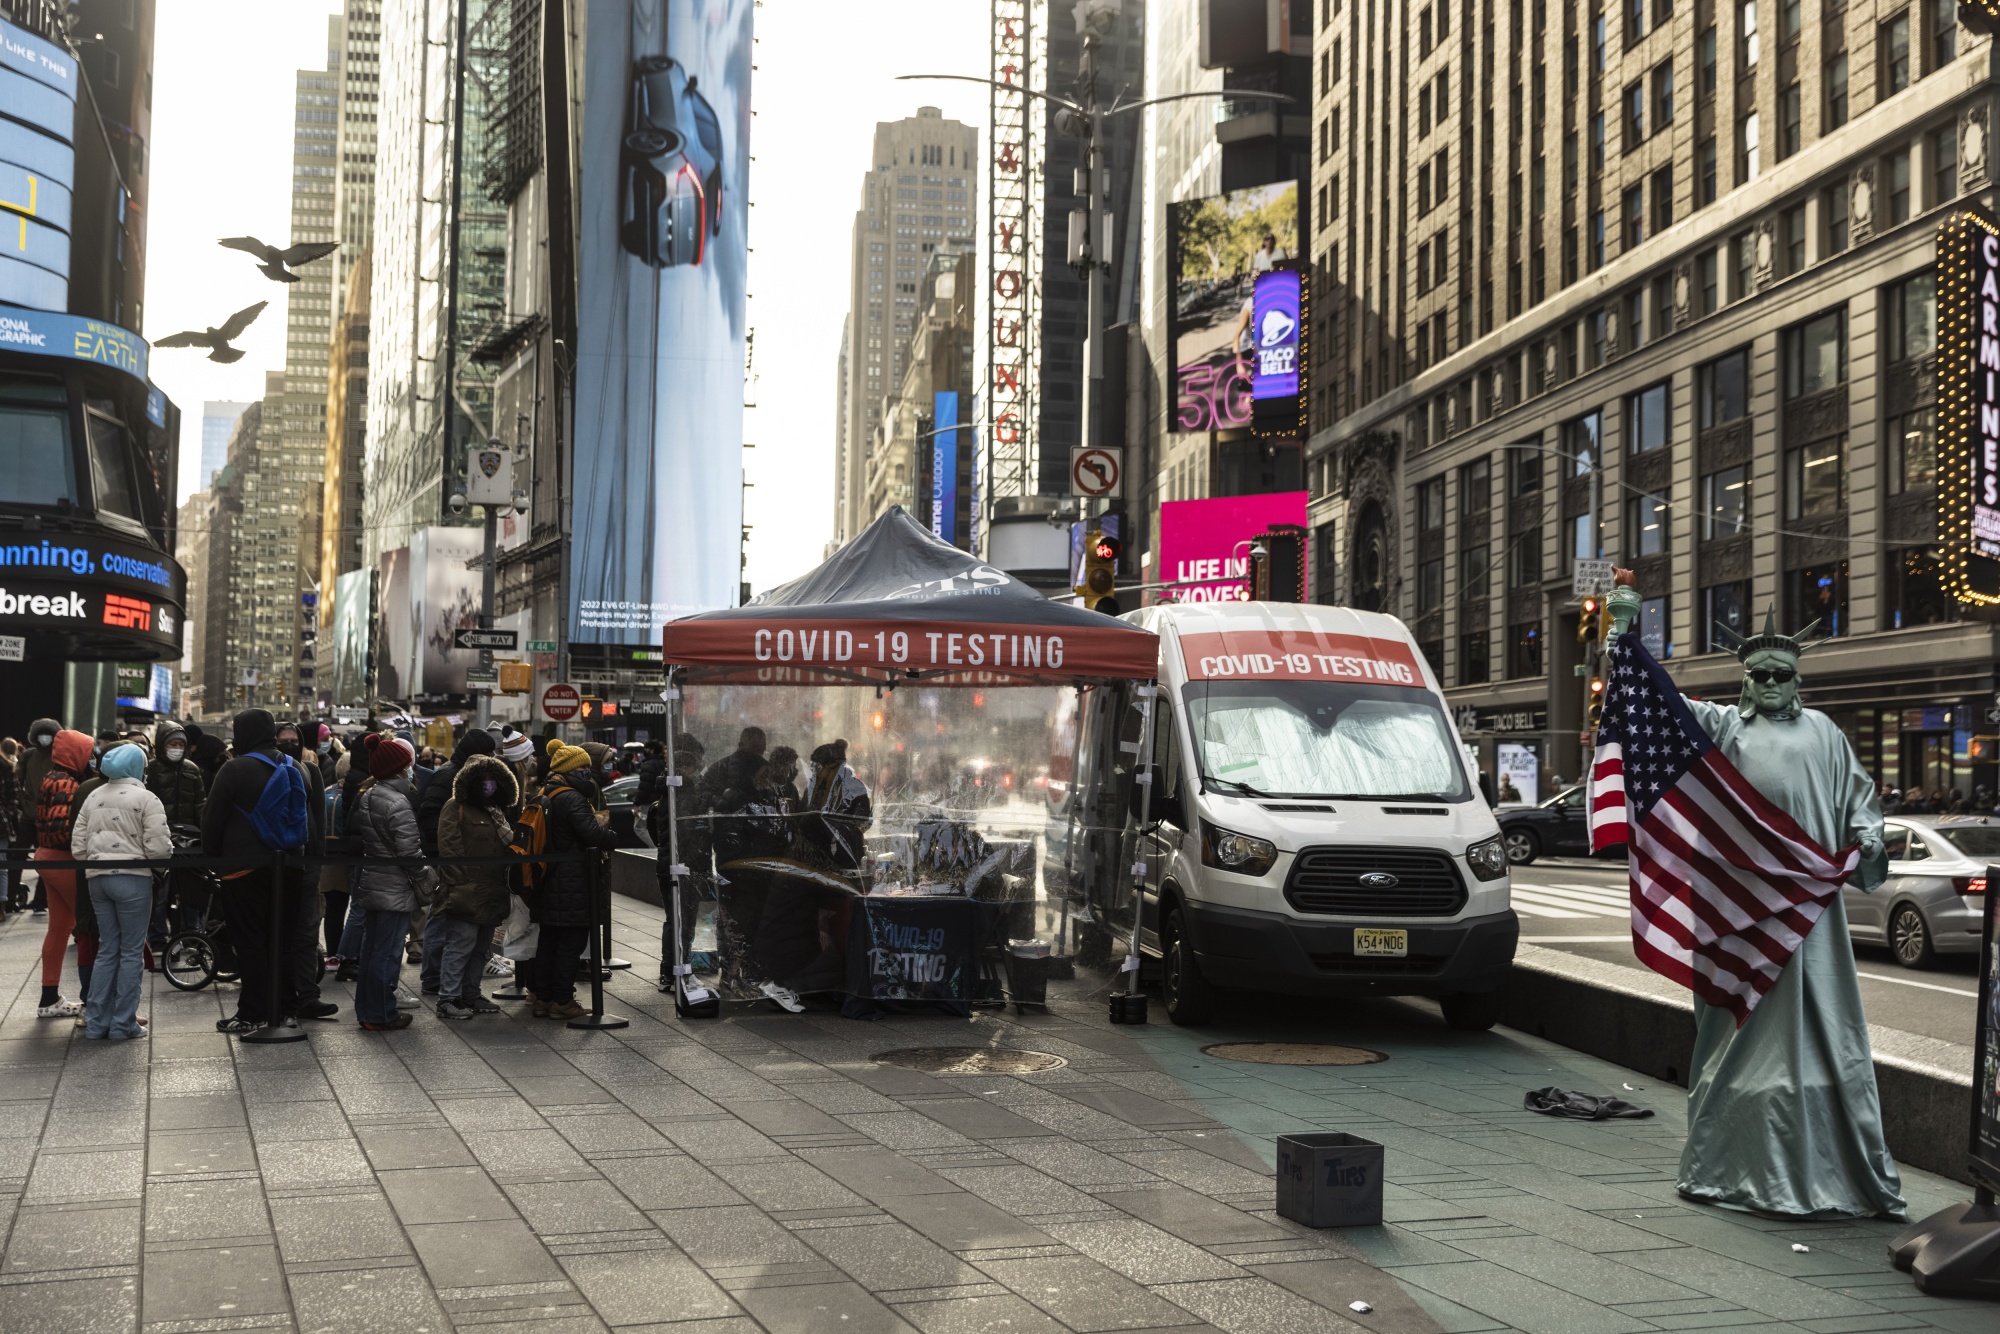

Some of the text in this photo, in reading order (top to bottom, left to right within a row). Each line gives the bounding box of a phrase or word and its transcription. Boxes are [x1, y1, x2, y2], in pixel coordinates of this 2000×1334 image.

[6, 38, 67, 79] LIKE THIS
[74, 331, 138, 372] EARTH
[1258, 347, 1295, 364] TACO
[1260, 361, 1295, 376] BELL
[933, 447, 943, 498] Outdoor
[1178, 557, 1247, 583] LIFE IN
[103, 594, 151, 631] ESPN
[581, 601, 600, 609] 2022
[602, 602, 618, 610] EV6
[619, 602, 649, 610] GT-Line
[581, 619, 628, 629] Professional
[629, 621, 652, 629] driver
[614, 612, 631, 620] may
[632, 613, 651, 621] vary.
[5, 640, 21, 648] ZONE
[464, 635, 509, 644] ONE WAY
[0, 649, 20, 657] OVING
[755, 629, 1063, 668] COVID-19 TESTING
[1200, 653, 1414, 684] COVID-19 TESTING
[1494, 711, 1535, 731] TACO BELL
[1369, 875, 1390, 885] Ford
[884, 925, 945, 951] OVID-19
[1357, 935, 1404, 950] K54 NDG
